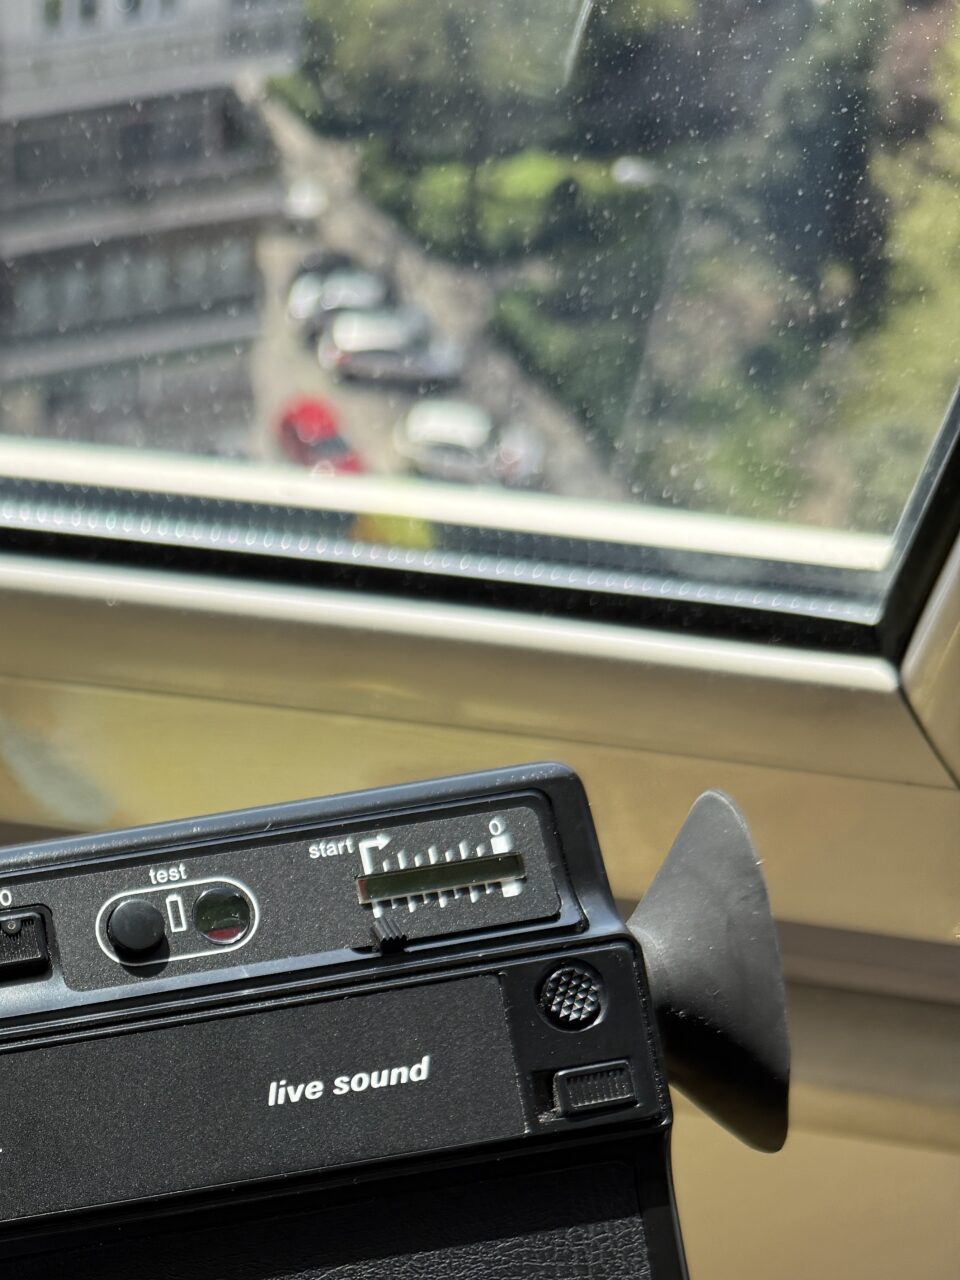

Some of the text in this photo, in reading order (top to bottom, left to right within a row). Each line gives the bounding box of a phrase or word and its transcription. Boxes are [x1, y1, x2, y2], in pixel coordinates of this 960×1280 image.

[308, 836, 355, 860] start
[148, 862, 189, 885] test
[267, 1054, 431, 1107] live sound
